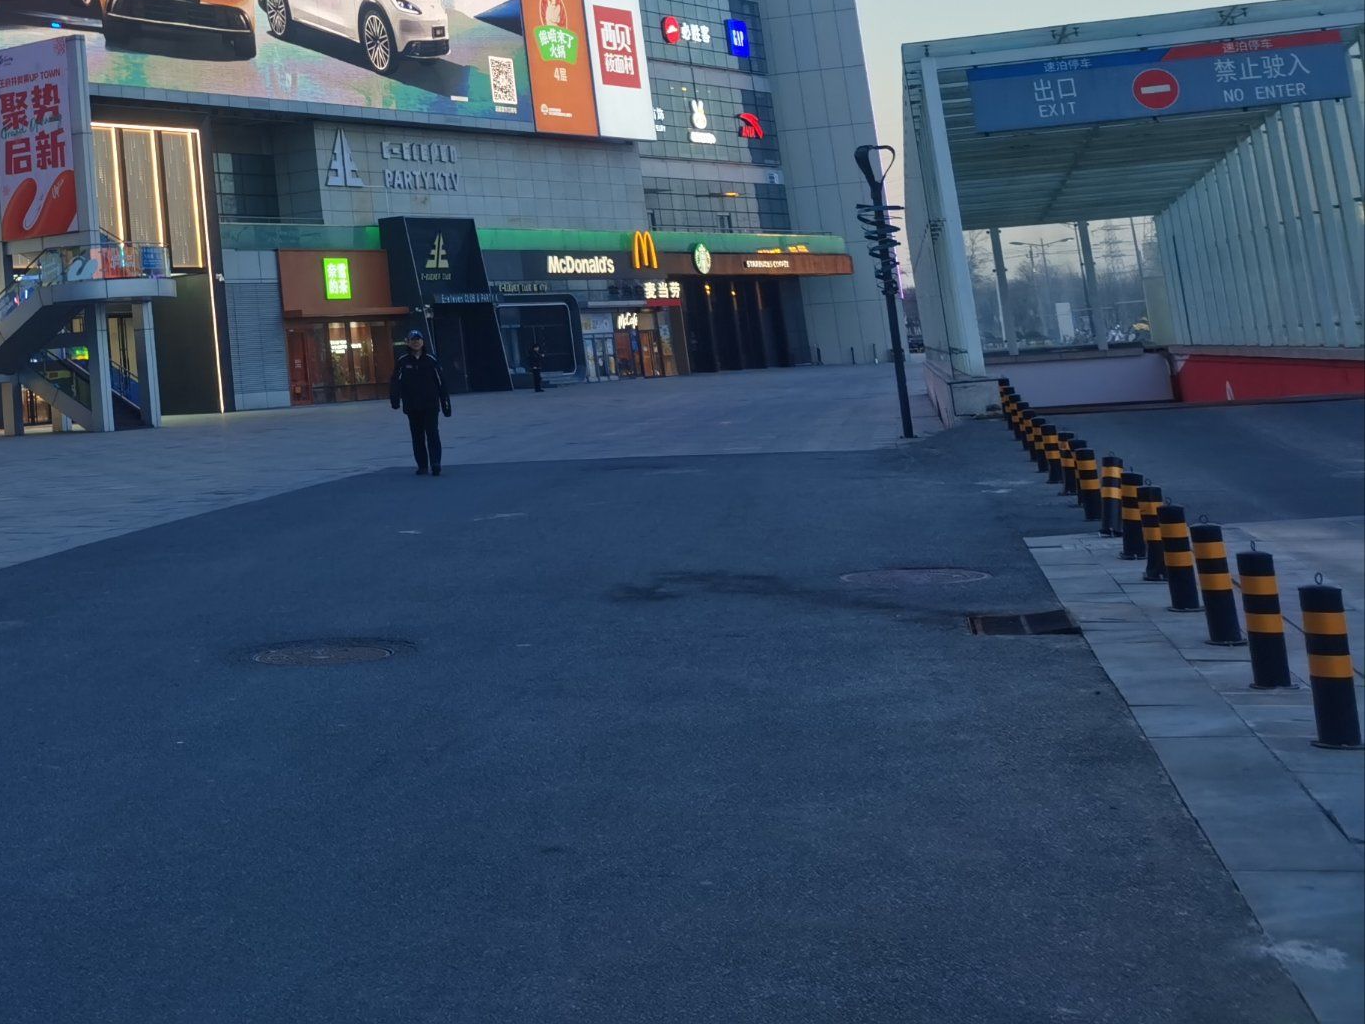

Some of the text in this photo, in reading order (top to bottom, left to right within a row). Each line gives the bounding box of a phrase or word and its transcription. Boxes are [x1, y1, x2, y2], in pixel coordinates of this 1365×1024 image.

[600, 21, 631, 52] 西贝
[1214, 52, 1311, 84] 禁止驶入
[1034, 77, 1077, 104] 出口
[1223, 82, 1307, 103] NO ENTER
[0, 83, 60, 130] 聚势
[1039, 102, 1077, 118] EXIT
[547, 256, 615, 274] McDonald's
[644, 282, 681, 299] 麦当劳
